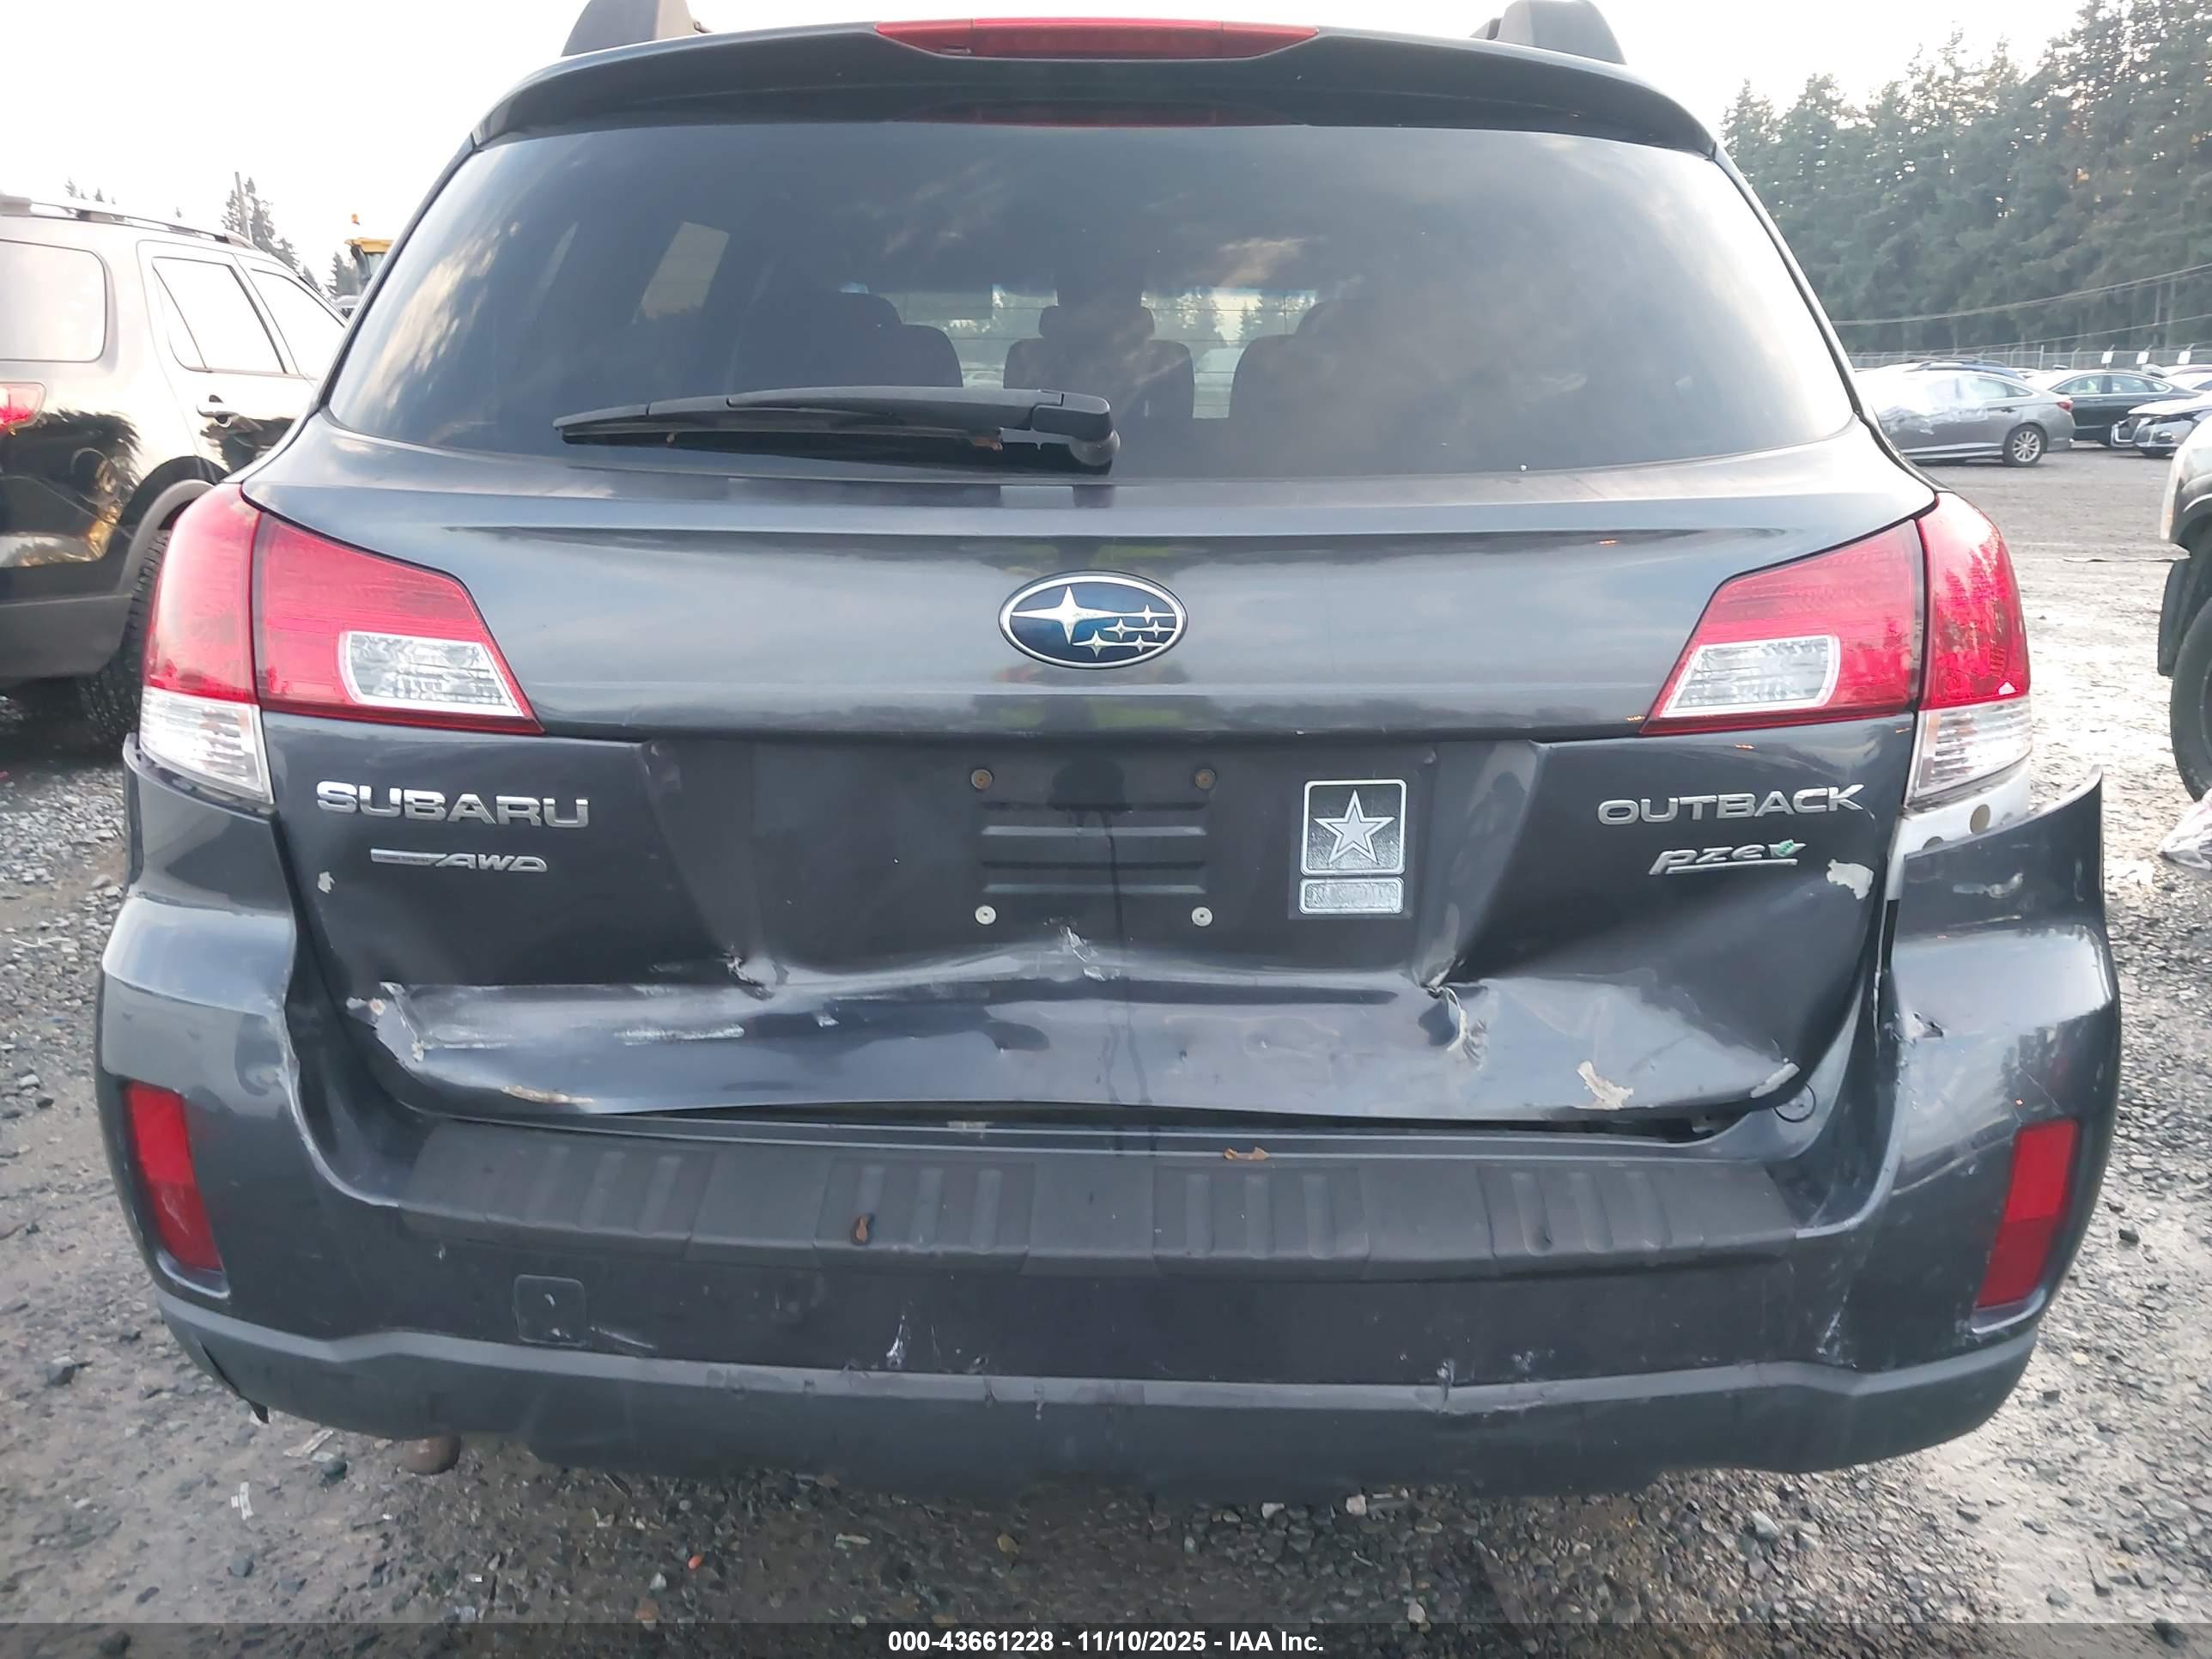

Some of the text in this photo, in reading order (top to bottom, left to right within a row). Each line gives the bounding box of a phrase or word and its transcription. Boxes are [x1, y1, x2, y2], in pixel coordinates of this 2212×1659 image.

[316, 780, 589, 829] SUBARU
[1597, 784, 1865, 825] OUTBACK
[435, 853, 548, 872] AWD
